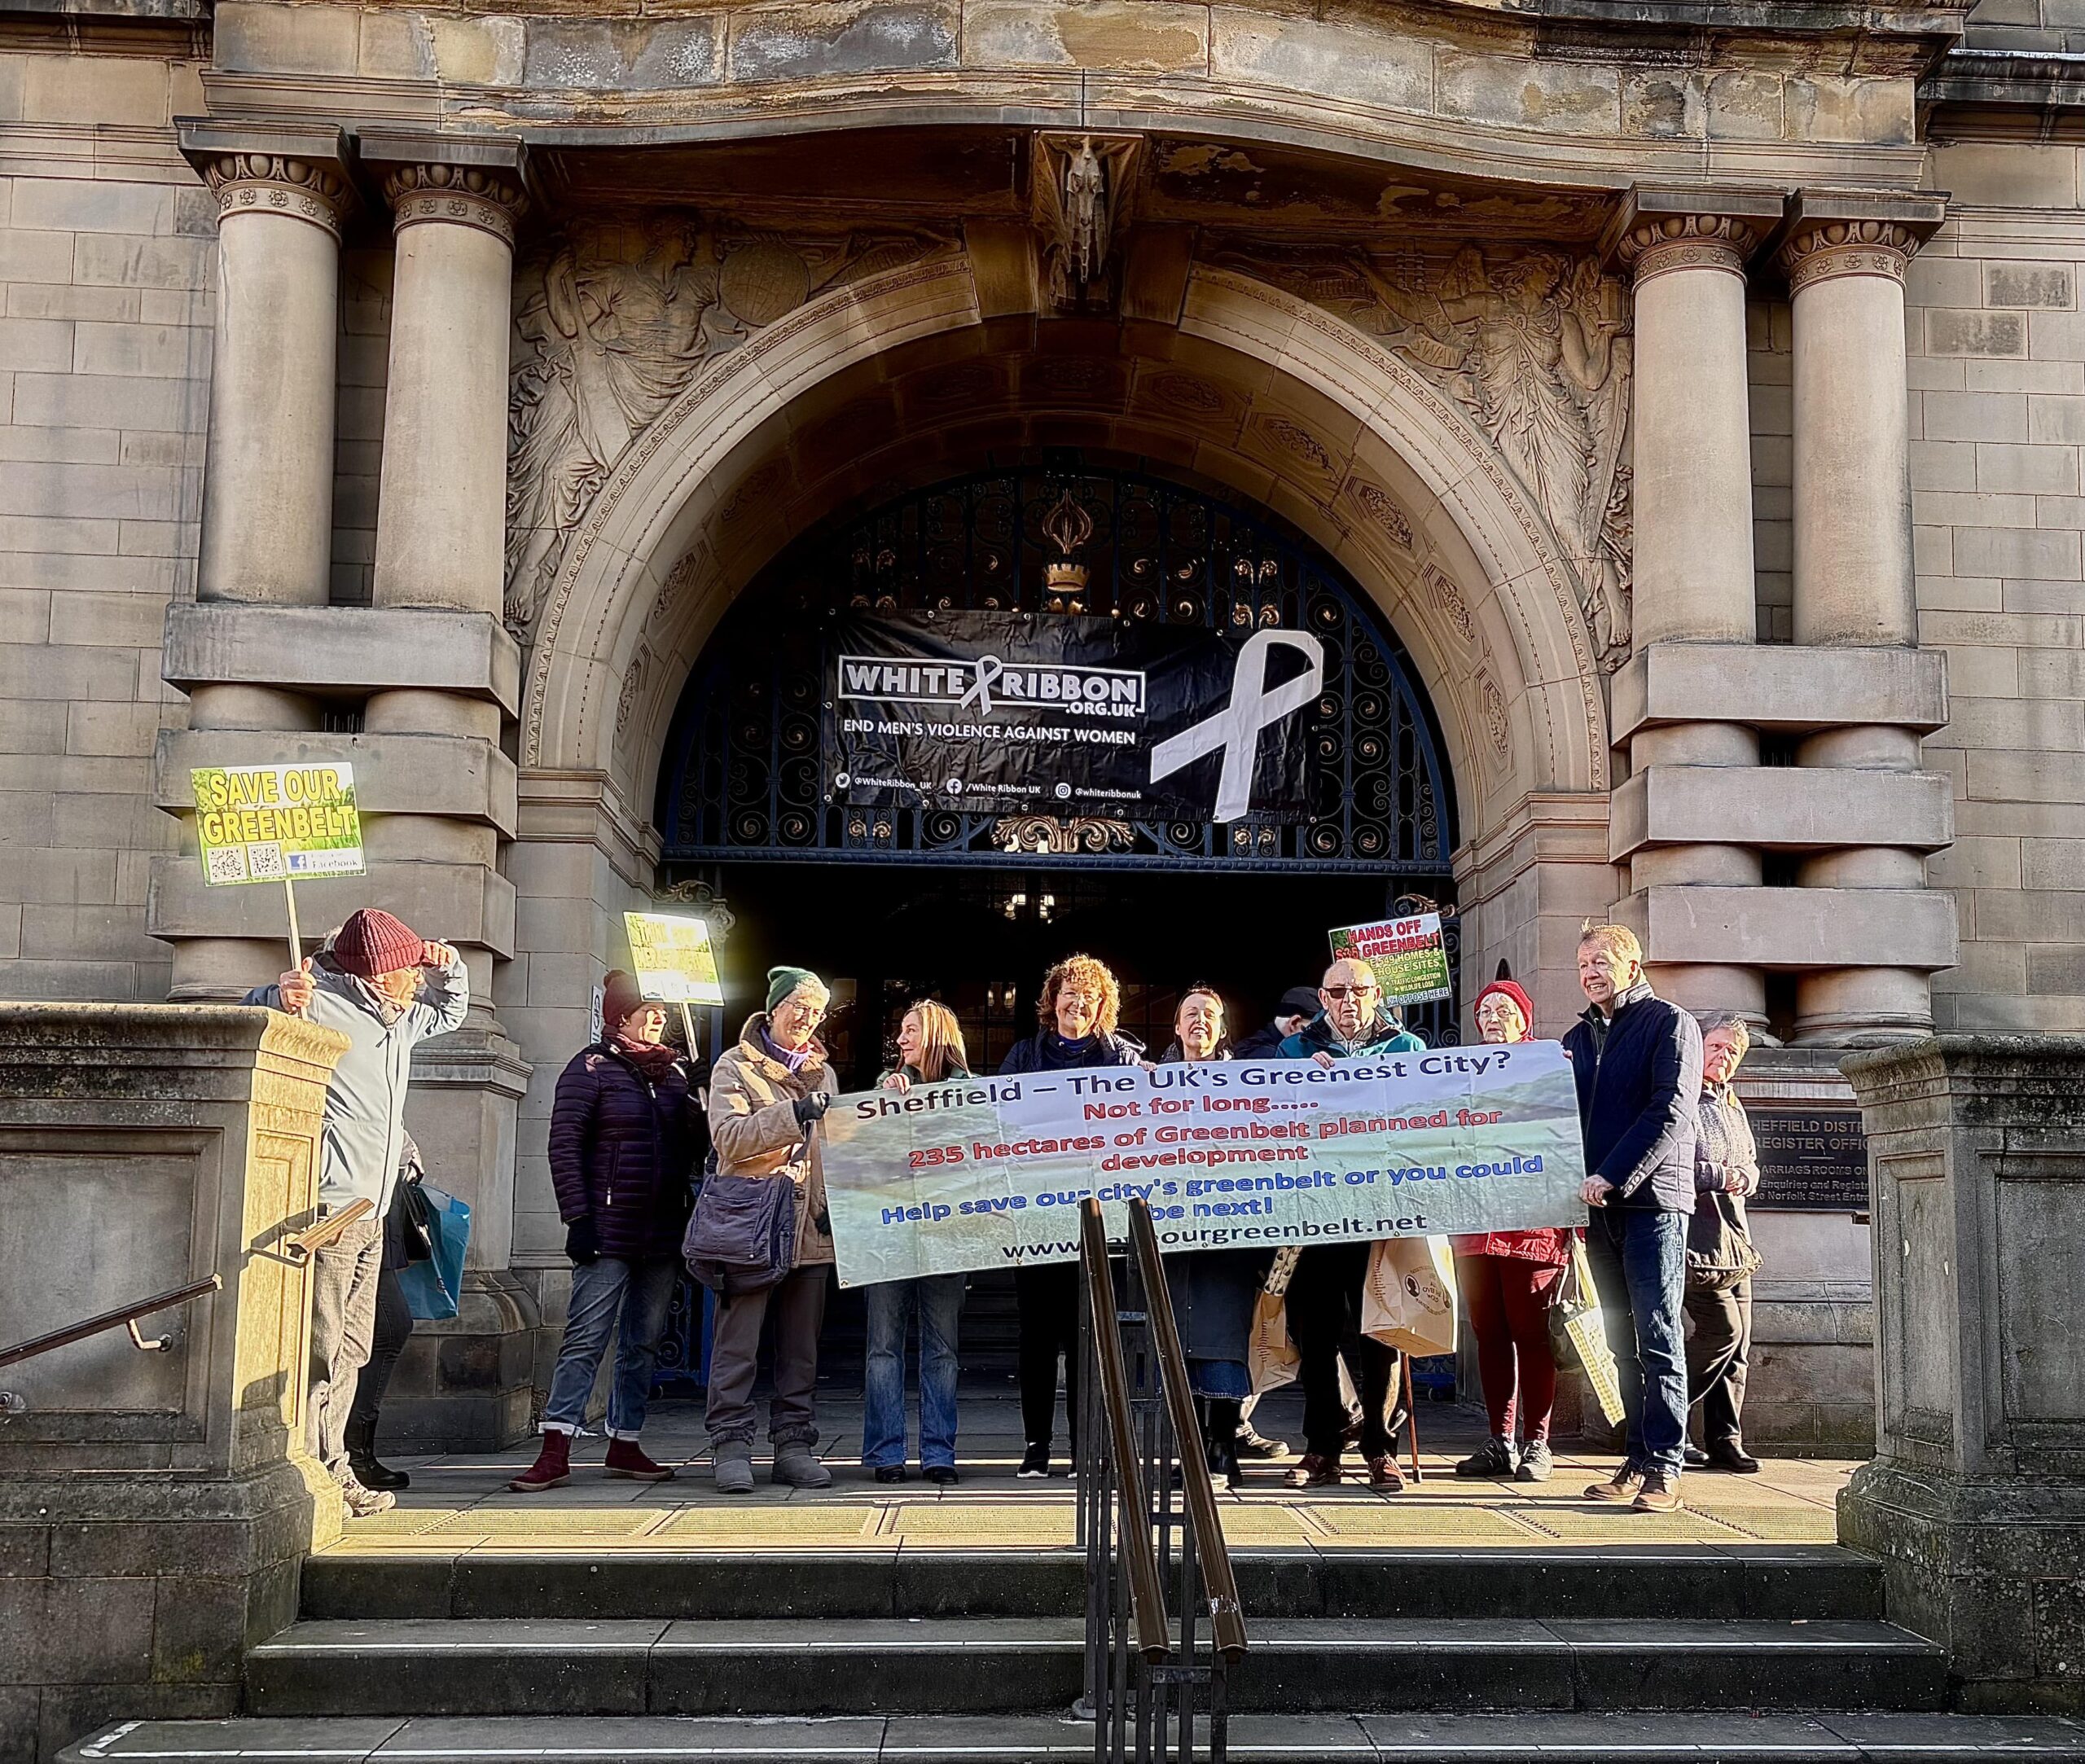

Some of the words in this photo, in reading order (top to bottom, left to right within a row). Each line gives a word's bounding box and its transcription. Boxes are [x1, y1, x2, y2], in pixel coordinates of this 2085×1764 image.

[846, 665, 964, 695] WHITE
[1002, 674, 1136, 703] RIBBON
[1065, 701, 1136, 718] .ORG.UK
[843, 719, 876, 735] END
[877, 720, 924, 736] MEN'S
[928, 723, 1003, 739] VIOLENCE
[1003, 726, 1070, 742] AGAINST
[1073, 728, 1135, 744] WOMEN
[208, 771, 280, 806] SAVE
[284, 769, 341, 802] OUR
[854, 779, 933, 792] @WhiteRibbon_UK
[997, 784, 1027, 794] Ribbon
[1029, 785, 1041, 794] UK
[1075, 788, 1142, 800] @whiteribbonuk
[203, 805, 354, 845] GREENBELT
[1347, 924, 1393, 944] HANDS
[1396, 919, 1421, 936] OFF
[1362, 932, 1440, 958] GREENBELT
[1398, 950, 1431, 962] HOMES
[1412, 959, 1440, 972] SITES
[1422, 981, 1434, 989] LOSS
[1398, 991, 1428, 1004] OPPOSE
[1429, 988, 1449, 998] HERE
[856, 1082, 1022, 1120] Sheffield
[1066, 1075, 1135, 1095] The
[1149, 1068, 1228, 1089] UK's
[1240, 1062, 1407, 1086] Greenest
[1419, 1051, 1512, 1075] City?
[1083, 1103, 1142, 1121] Not
[1149, 1097, 1195, 1115] for
[1751, 1119, 1820, 1133] HEFFIELD
[908, 1145, 964, 1168] 235
[972, 1135, 1105, 1161] hectares
[1114, 1127, 1148, 1147] of
[1155, 1121, 1310, 1143] Greenbelt
[1319, 1111, 1448, 1139] planned
[1456, 1108, 1502, 1126] for
[1756, 1137, 1824, 1149] REGISTER
[1829, 1138, 1868, 1151] OFFIC
[1101, 1146, 1309, 1171] development
[881, 1202, 951, 1225] Help
[959, 1195, 1027, 1215] save
[1097, 1178, 1178, 1201] city's
[1186, 1170, 1337, 1196] greenbelt
[1345, 1167, 1380, 1185] or
[1386, 1165, 1446, 1186] you
[1455, 1155, 1544, 1178] could
[1760, 1180, 1808, 1190] Enquiries
[1811, 1180, 1829, 1189] and
[1767, 1191, 1806, 1201] Norfolk
[1808, 1191, 1840, 1201] Street
[1151, 1204, 1185, 1221] be
[1192, 1196, 1274, 1217] next!
